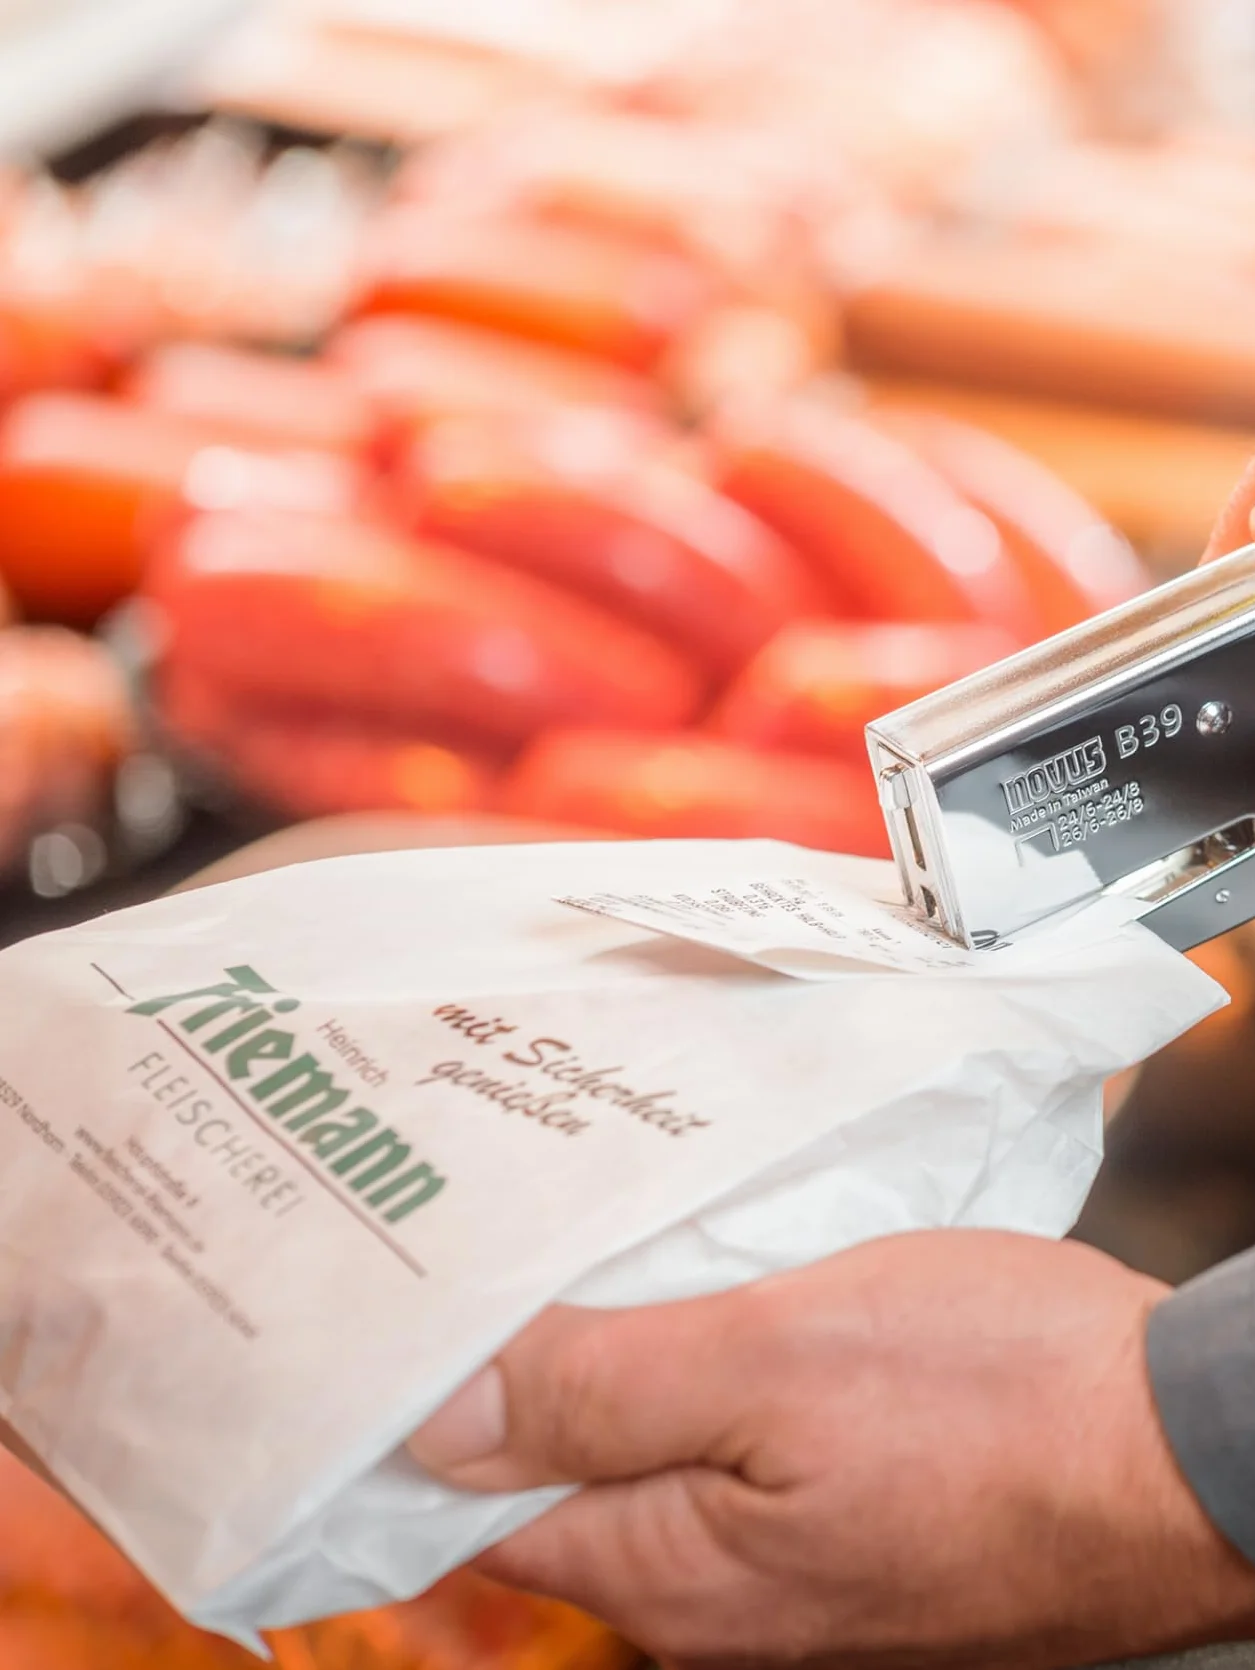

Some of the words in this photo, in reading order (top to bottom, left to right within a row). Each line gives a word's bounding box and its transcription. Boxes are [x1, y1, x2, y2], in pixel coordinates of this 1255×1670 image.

[1114, 703, 1182, 759] B39
[1009, 807, 1046, 833] Made
[1062, 778, 1109, 808] Taiwan
[1057, 781, 1141, 831] 24/6-24/8
[1061, 798, 1144, 847] 26/6-26/8
[316, 1018, 391, 1089] Heinrich
[433, 1003, 518, 1044] mit
[503, 1037, 712, 1136] Sicherheit
[125, 965, 446, 1225] Triemann
[414, 1060, 592, 1136] genießen
[127, 1051, 306, 1218] FLEISCHEREI
